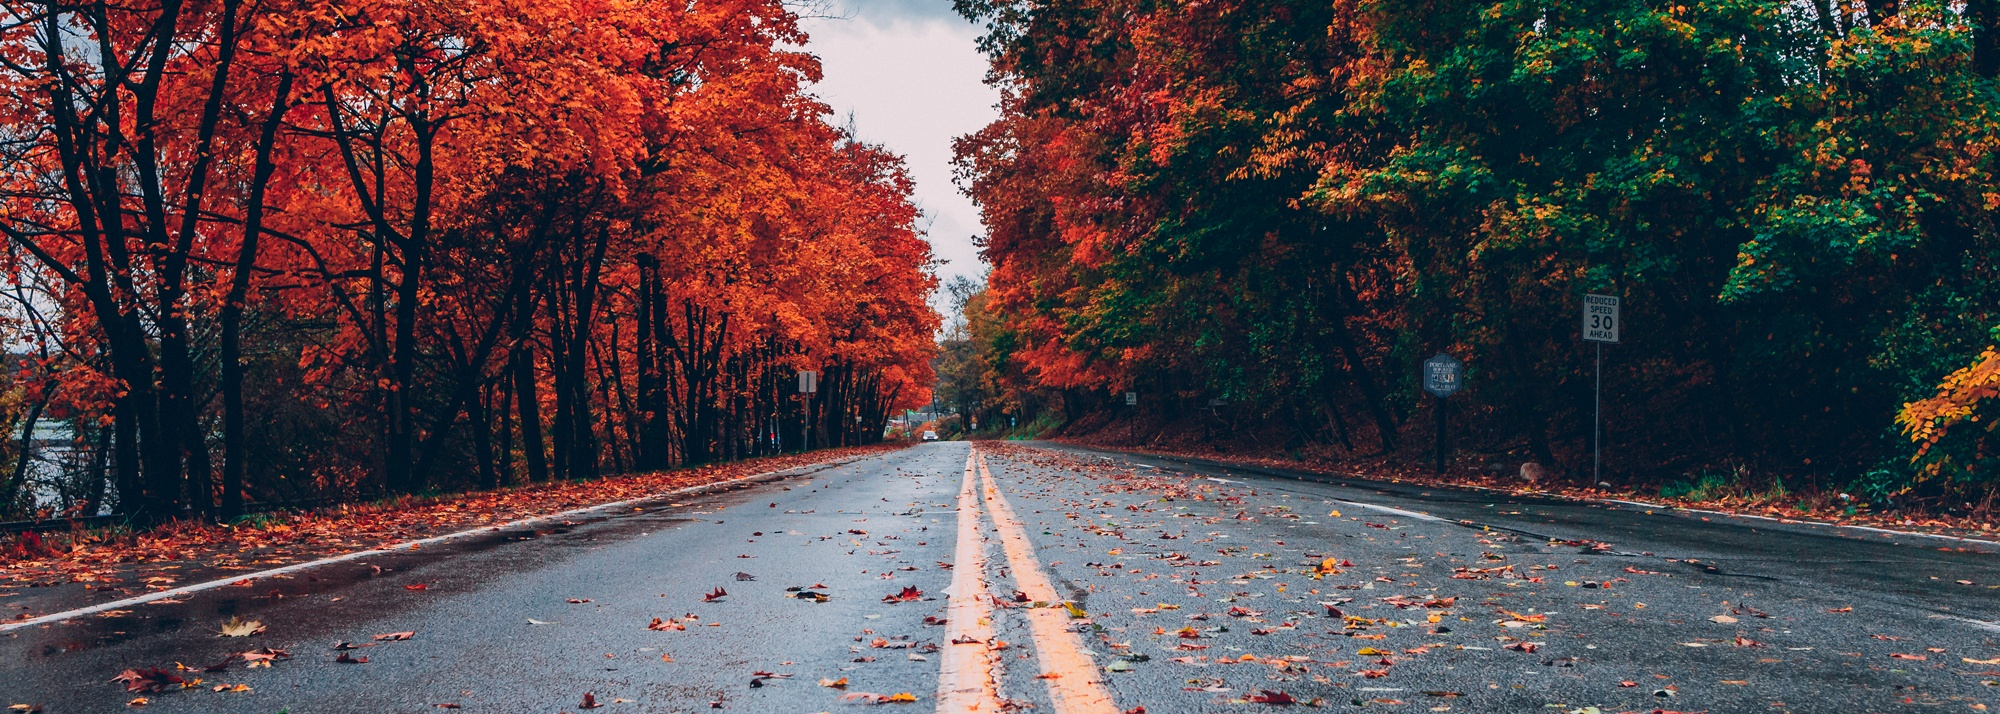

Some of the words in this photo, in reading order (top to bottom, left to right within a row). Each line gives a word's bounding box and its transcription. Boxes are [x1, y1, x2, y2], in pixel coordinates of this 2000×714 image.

[1585, 296, 1617, 306] REDUCED
[1590, 306, 1613, 315] SPEED
[1590, 314, 1613, 330] 30
[1589, 330, 1613, 339] AHEAD
